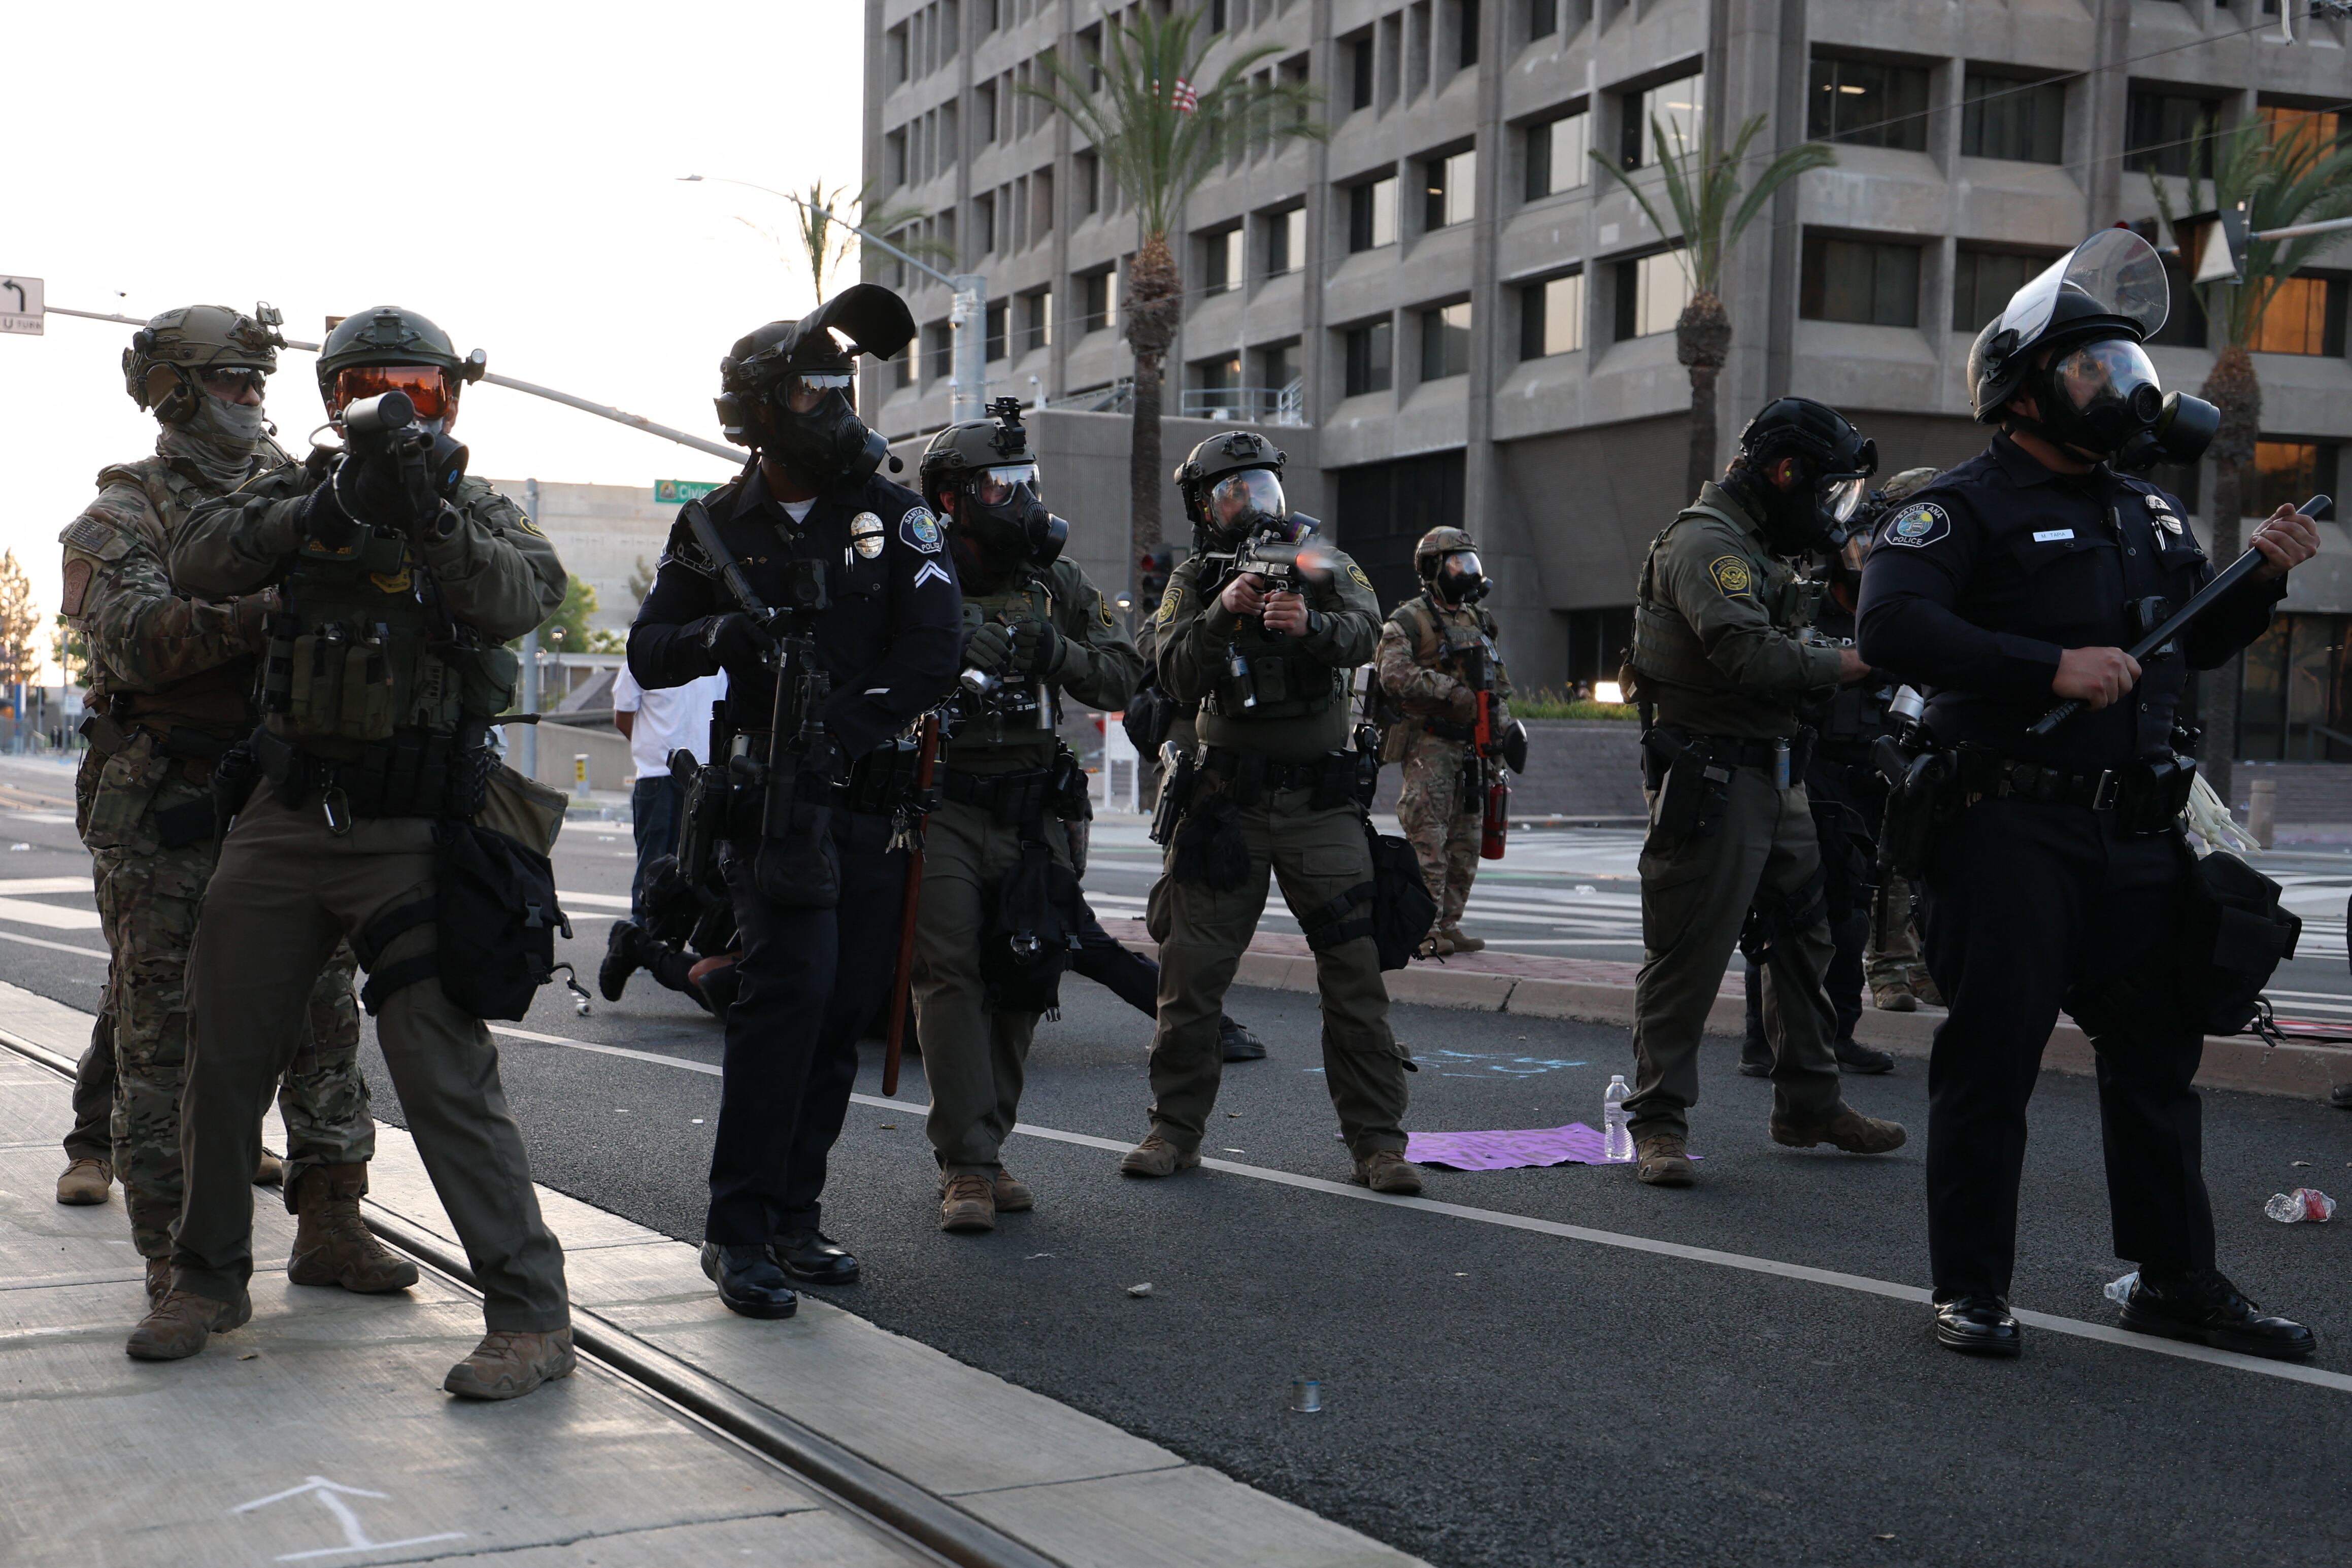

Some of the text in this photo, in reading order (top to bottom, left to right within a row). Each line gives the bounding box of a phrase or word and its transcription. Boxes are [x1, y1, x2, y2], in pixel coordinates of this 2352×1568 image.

[17, 319, 42, 329] TURN
[904, 508, 923, 525] SANTA
[1898, 505, 1944, 519] SANTA ANA
[1892, 536, 1923, 546] POLICE
